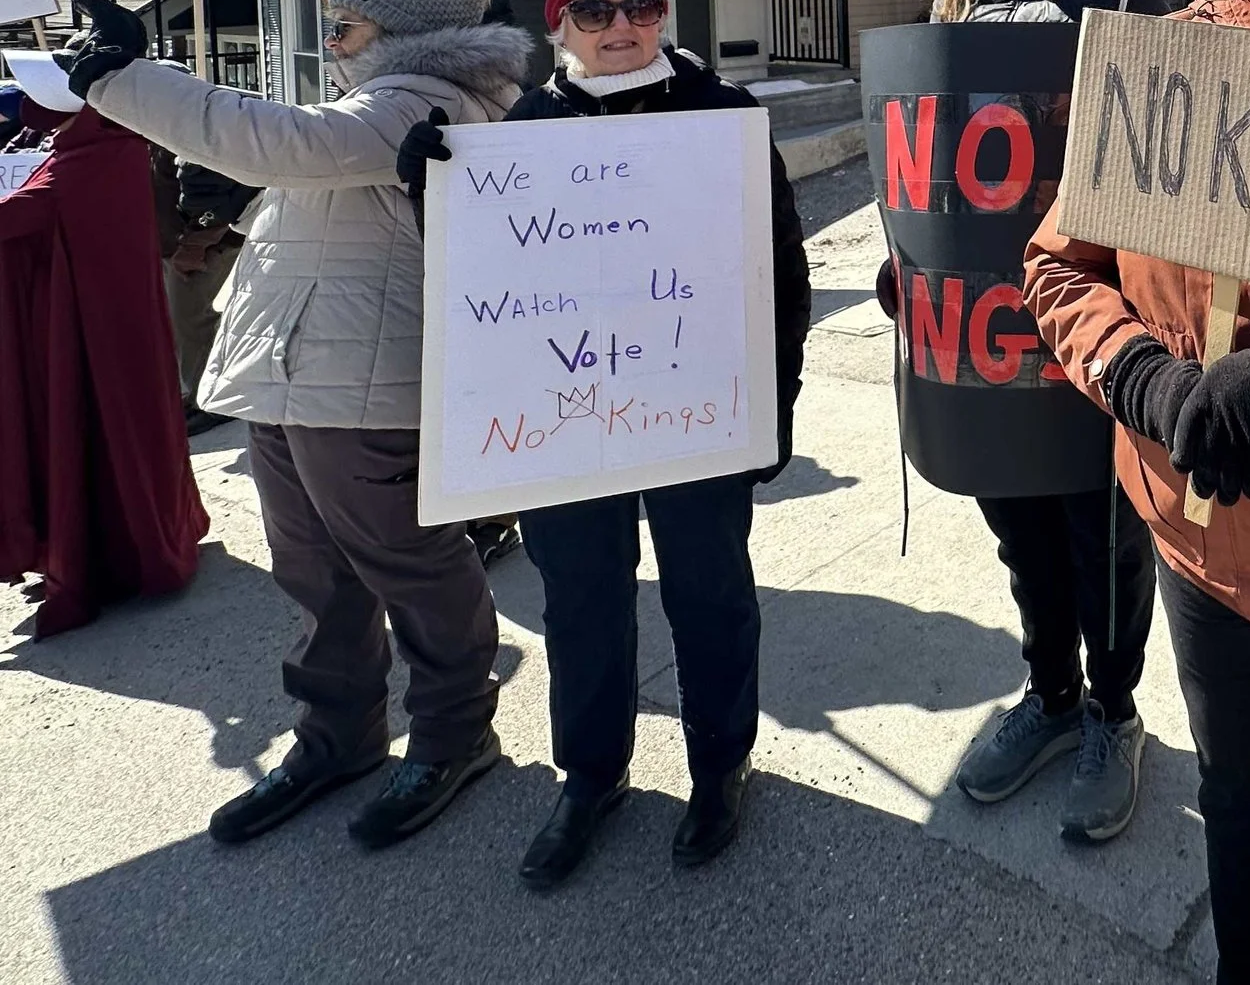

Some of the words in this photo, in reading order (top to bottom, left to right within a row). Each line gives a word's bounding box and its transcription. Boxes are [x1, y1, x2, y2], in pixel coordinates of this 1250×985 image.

[1091, 61, 1193, 198] NO
[885, 95, 1035, 212] NO
[465, 162, 532, 196] We
[571, 160, 631, 183] are
[508, 207, 649, 247] Women
[651, 268, 694, 301] Us
[481, 413, 545, 455] No
